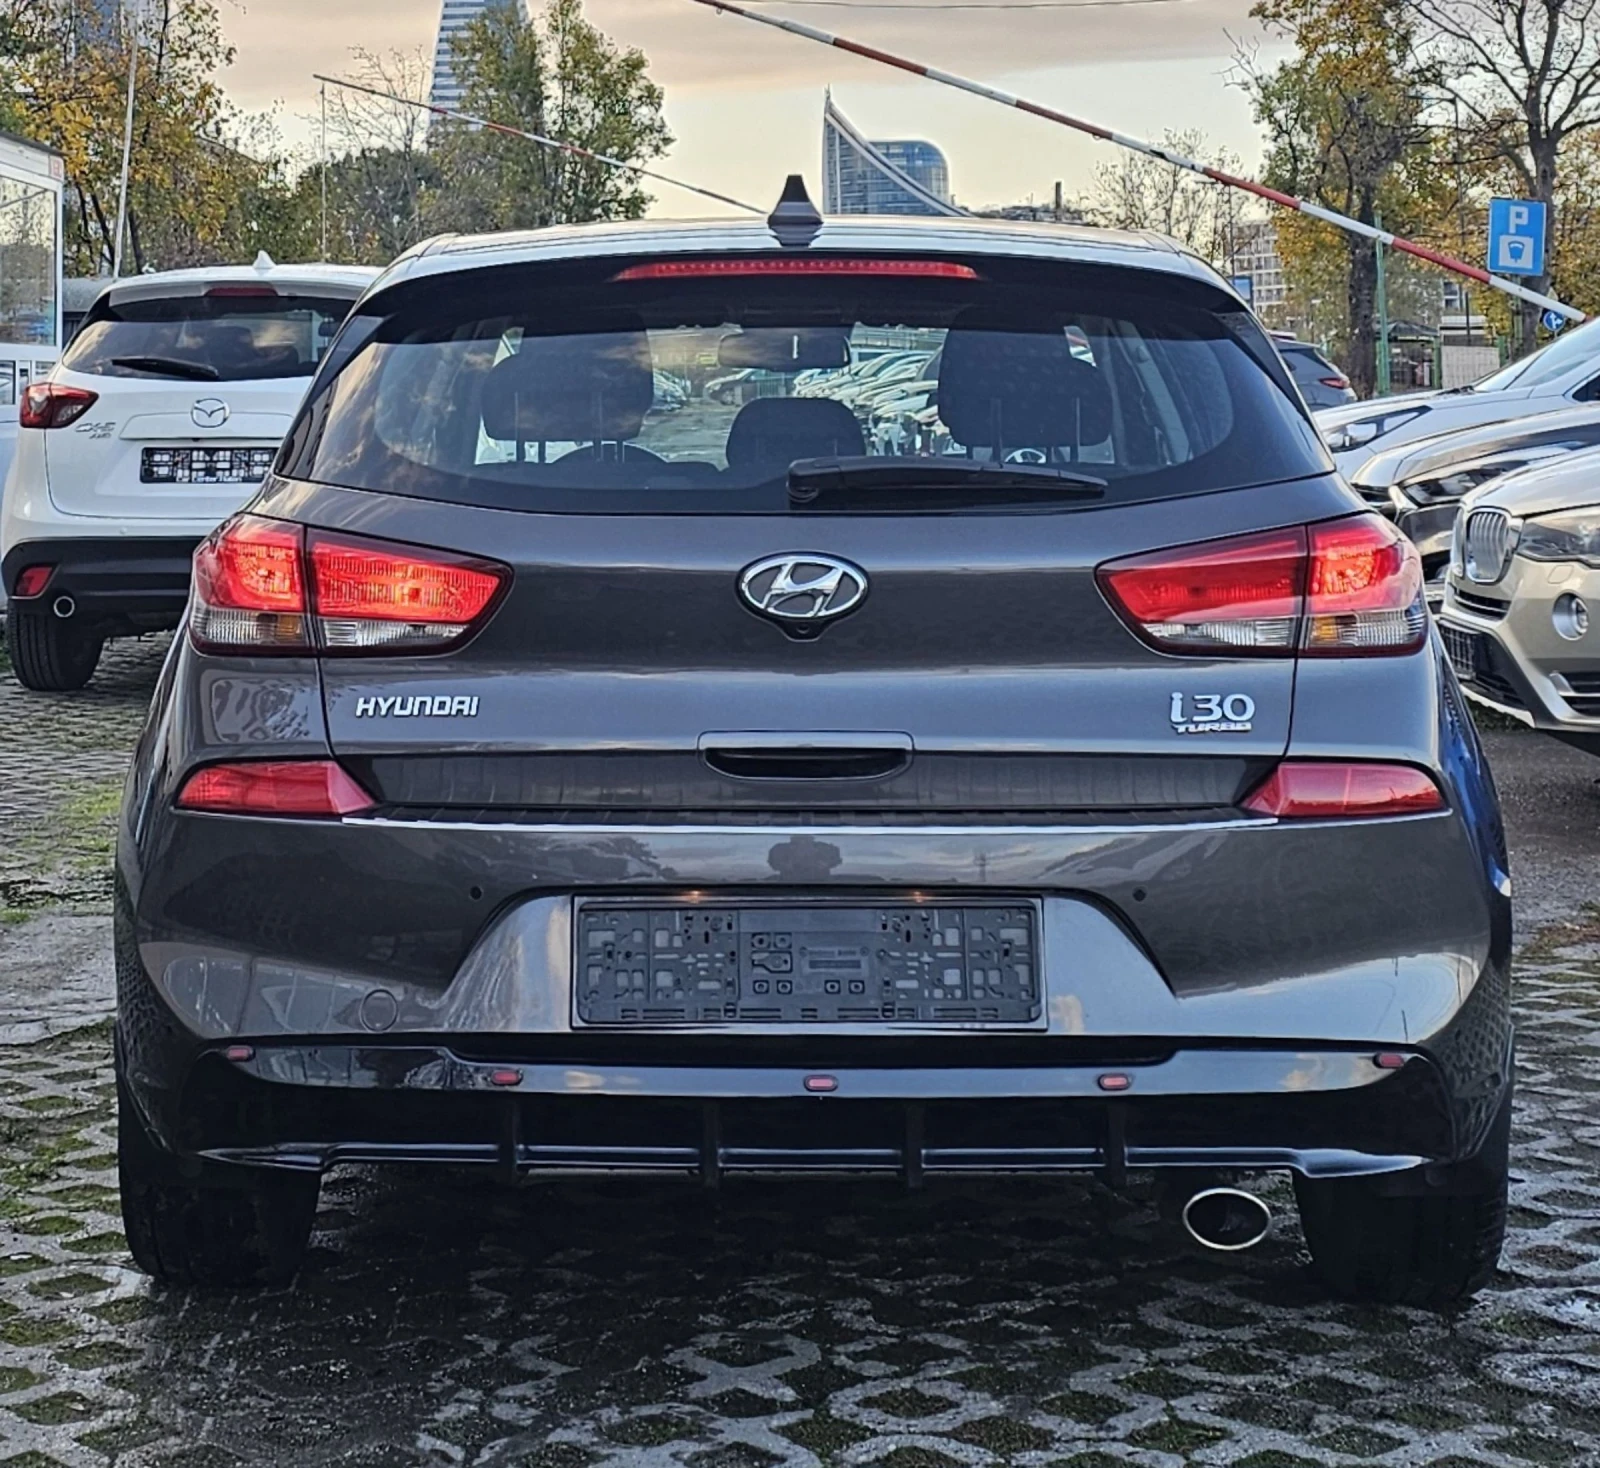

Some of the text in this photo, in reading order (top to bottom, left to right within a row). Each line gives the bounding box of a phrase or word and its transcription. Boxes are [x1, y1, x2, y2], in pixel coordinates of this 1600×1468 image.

[1509, 205, 1529, 234] P
[355, 696, 479, 717] HYUNDAI
[1170, 692, 1255, 722] i30
[1172, 722, 1252, 733] TURBO
